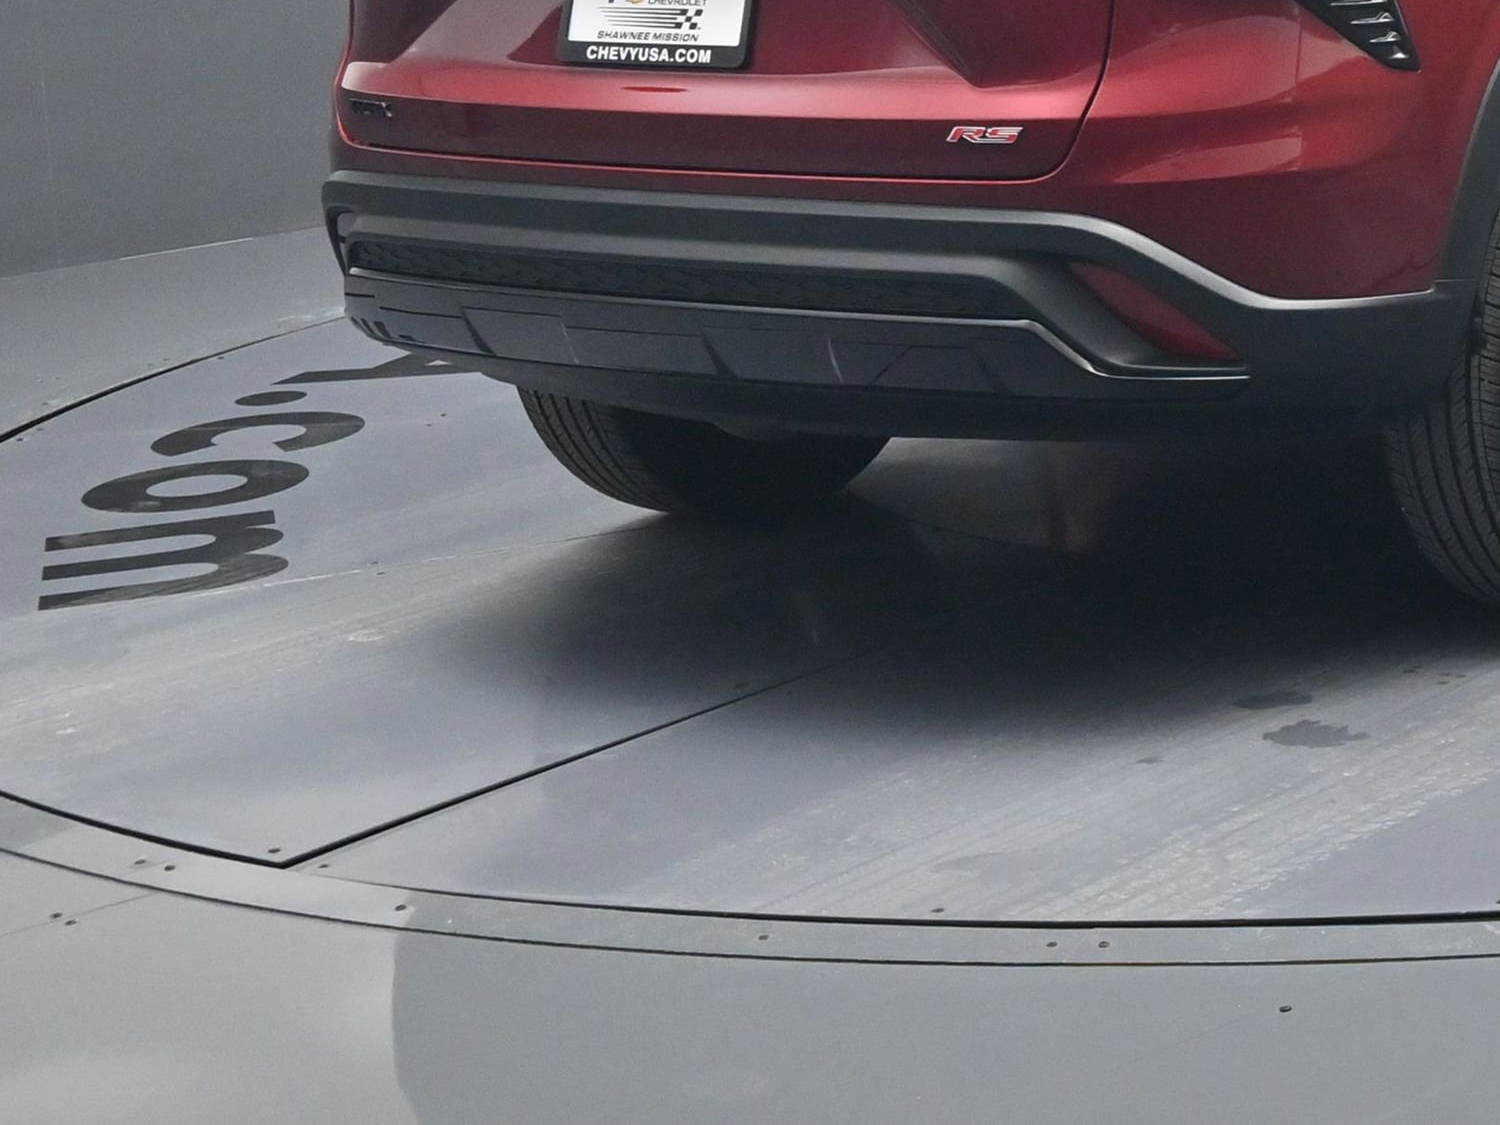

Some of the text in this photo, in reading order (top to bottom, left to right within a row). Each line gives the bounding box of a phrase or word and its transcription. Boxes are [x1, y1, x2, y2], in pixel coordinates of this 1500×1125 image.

[596, 30, 699, 43] SHAWNEE MISSION
[586, 46, 712, 63] CHEVYUSA.COM
[946, 126, 1024, 144] RS
